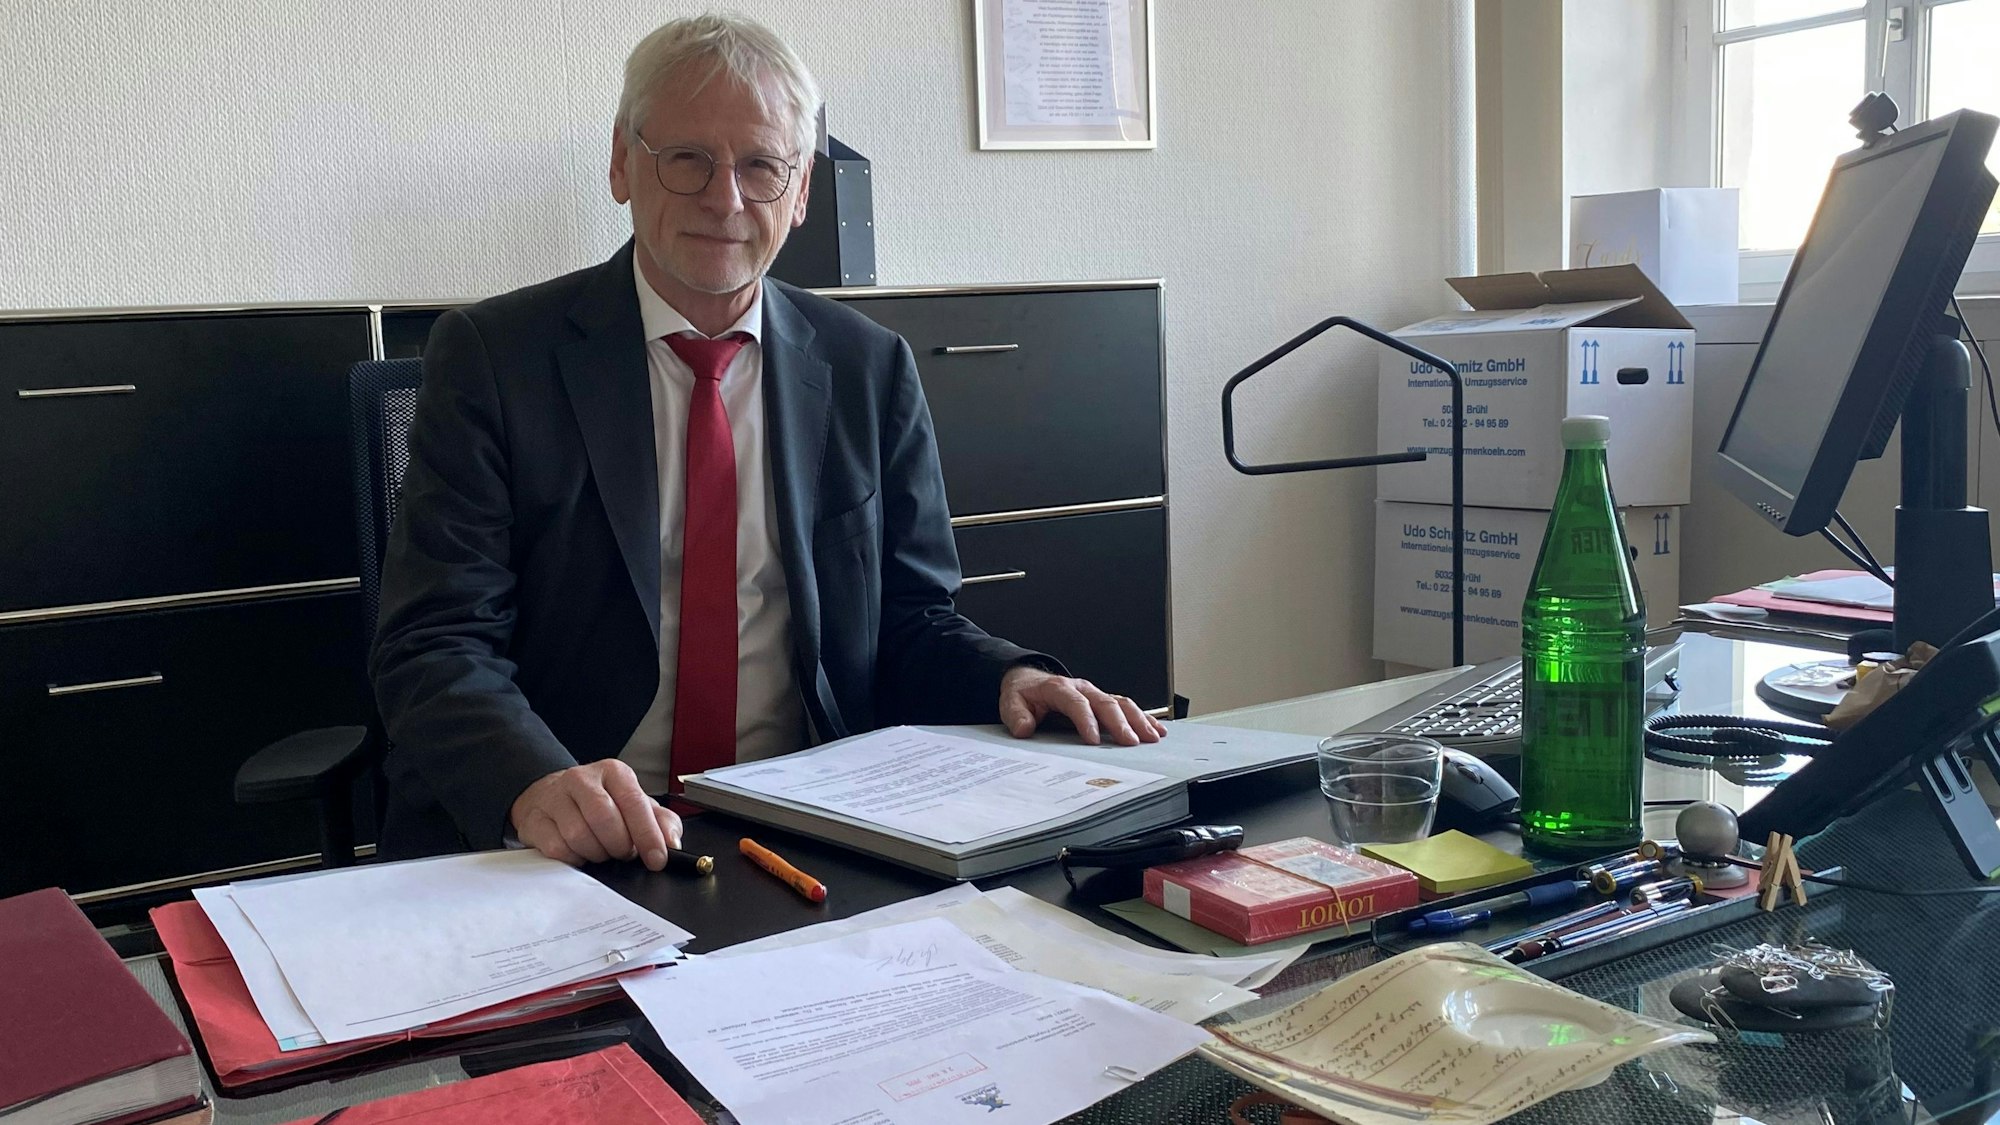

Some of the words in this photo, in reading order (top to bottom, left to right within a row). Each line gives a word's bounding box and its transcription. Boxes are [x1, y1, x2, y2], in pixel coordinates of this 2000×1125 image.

[1410, 361, 1433, 374] Udo
[1486, 358, 1526, 373] GmbH
[1464, 377, 1528, 388] Umzugsservice
[1466, 404, 1489, 414] Brühl
[1423, 418, 1439, 428] Tel.:
[1440, 418, 1446, 428] 0
[1475, 418, 1485, 428] 94
[1486, 418, 1497, 428] 95
[1498, 418, 1509, 429] 89
[1403, 524, 1426, 538] Udo
[1479, 530, 1518, 546] GmbH
[1464, 548, 1521, 560] mzugsservice
[1434, 569, 1454, 580] 5032
[1416, 580, 1432, 591] Tel.:
[1433, 582, 1439, 592] 0
[1440, 583, 1450, 593] 22
[1468, 586, 1478, 596] 94
[1480, 587, 1489, 598] 95
[1297, 893, 1376, 930] LORIOT
